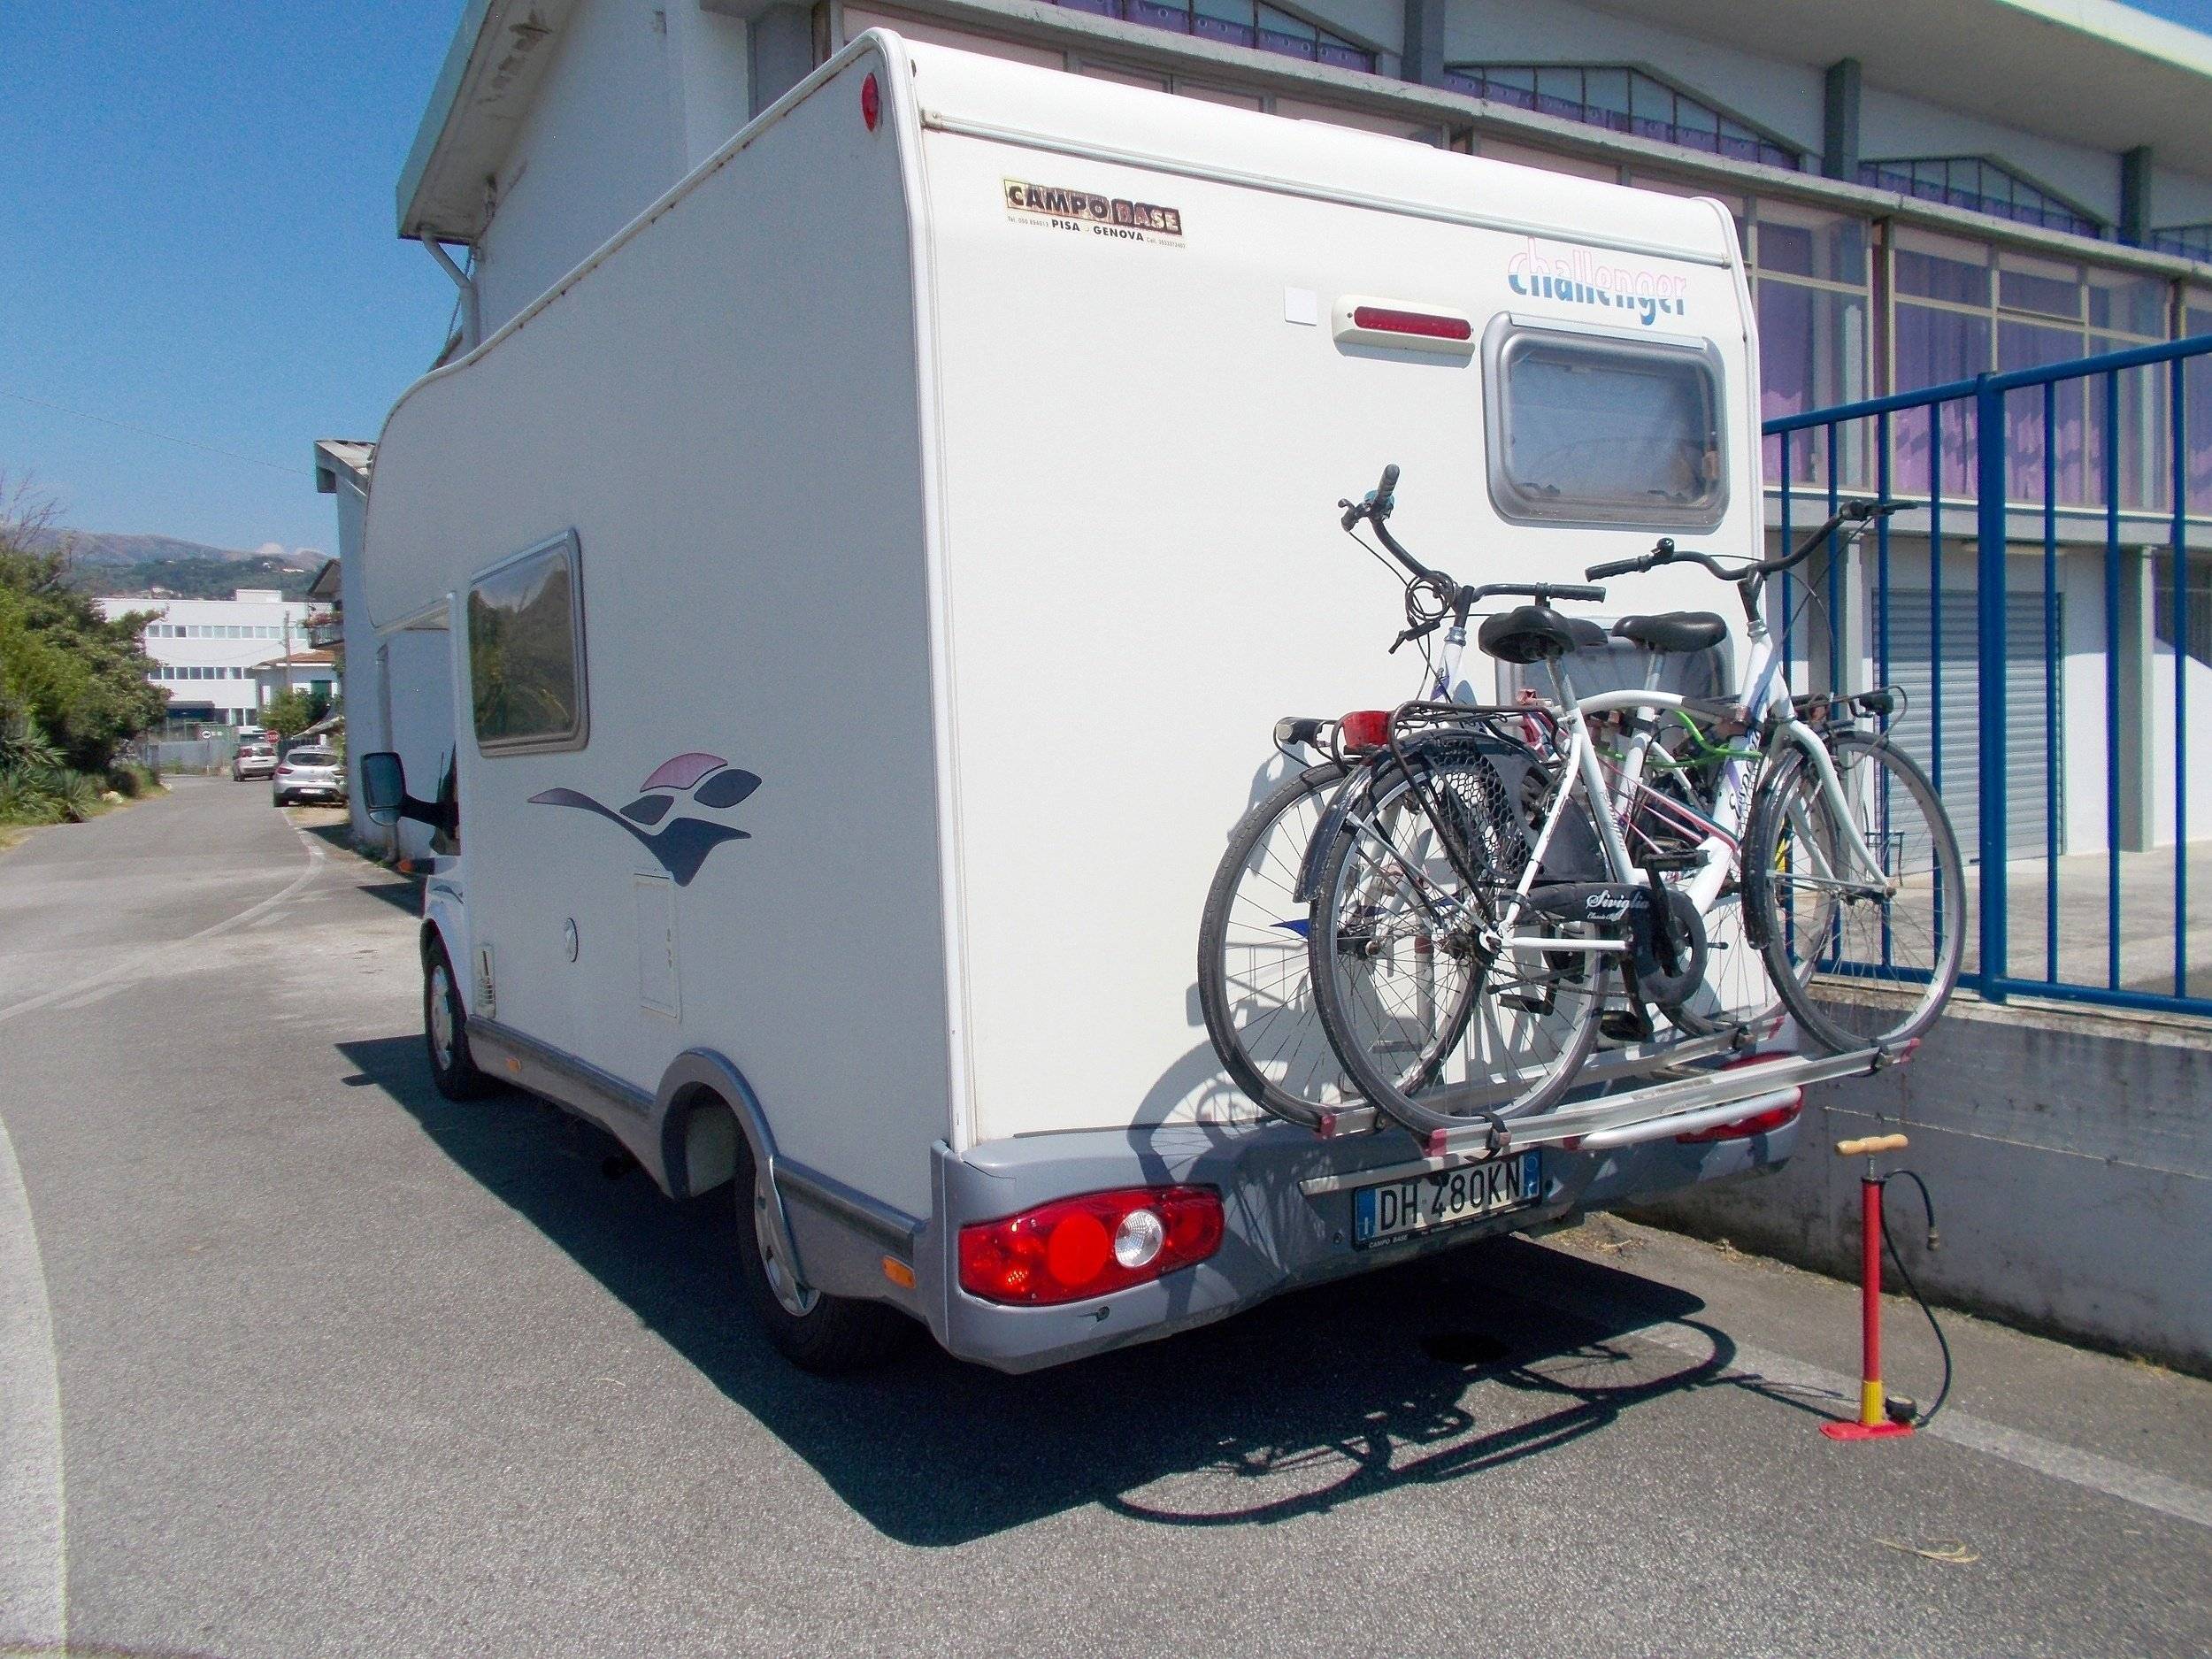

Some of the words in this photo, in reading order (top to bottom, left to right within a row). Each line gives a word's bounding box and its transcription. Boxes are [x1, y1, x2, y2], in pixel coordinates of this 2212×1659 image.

[1009, 185, 1109, 219] CAMPO
[1051, 219, 1080, 232] PISA
[1094, 226, 1144, 242] GENOVA
[1507, 236, 1687, 326] challenger
[1380, 1182, 1418, 1231] DH
[1369, 1238, 1391, 1249] CAMPO
